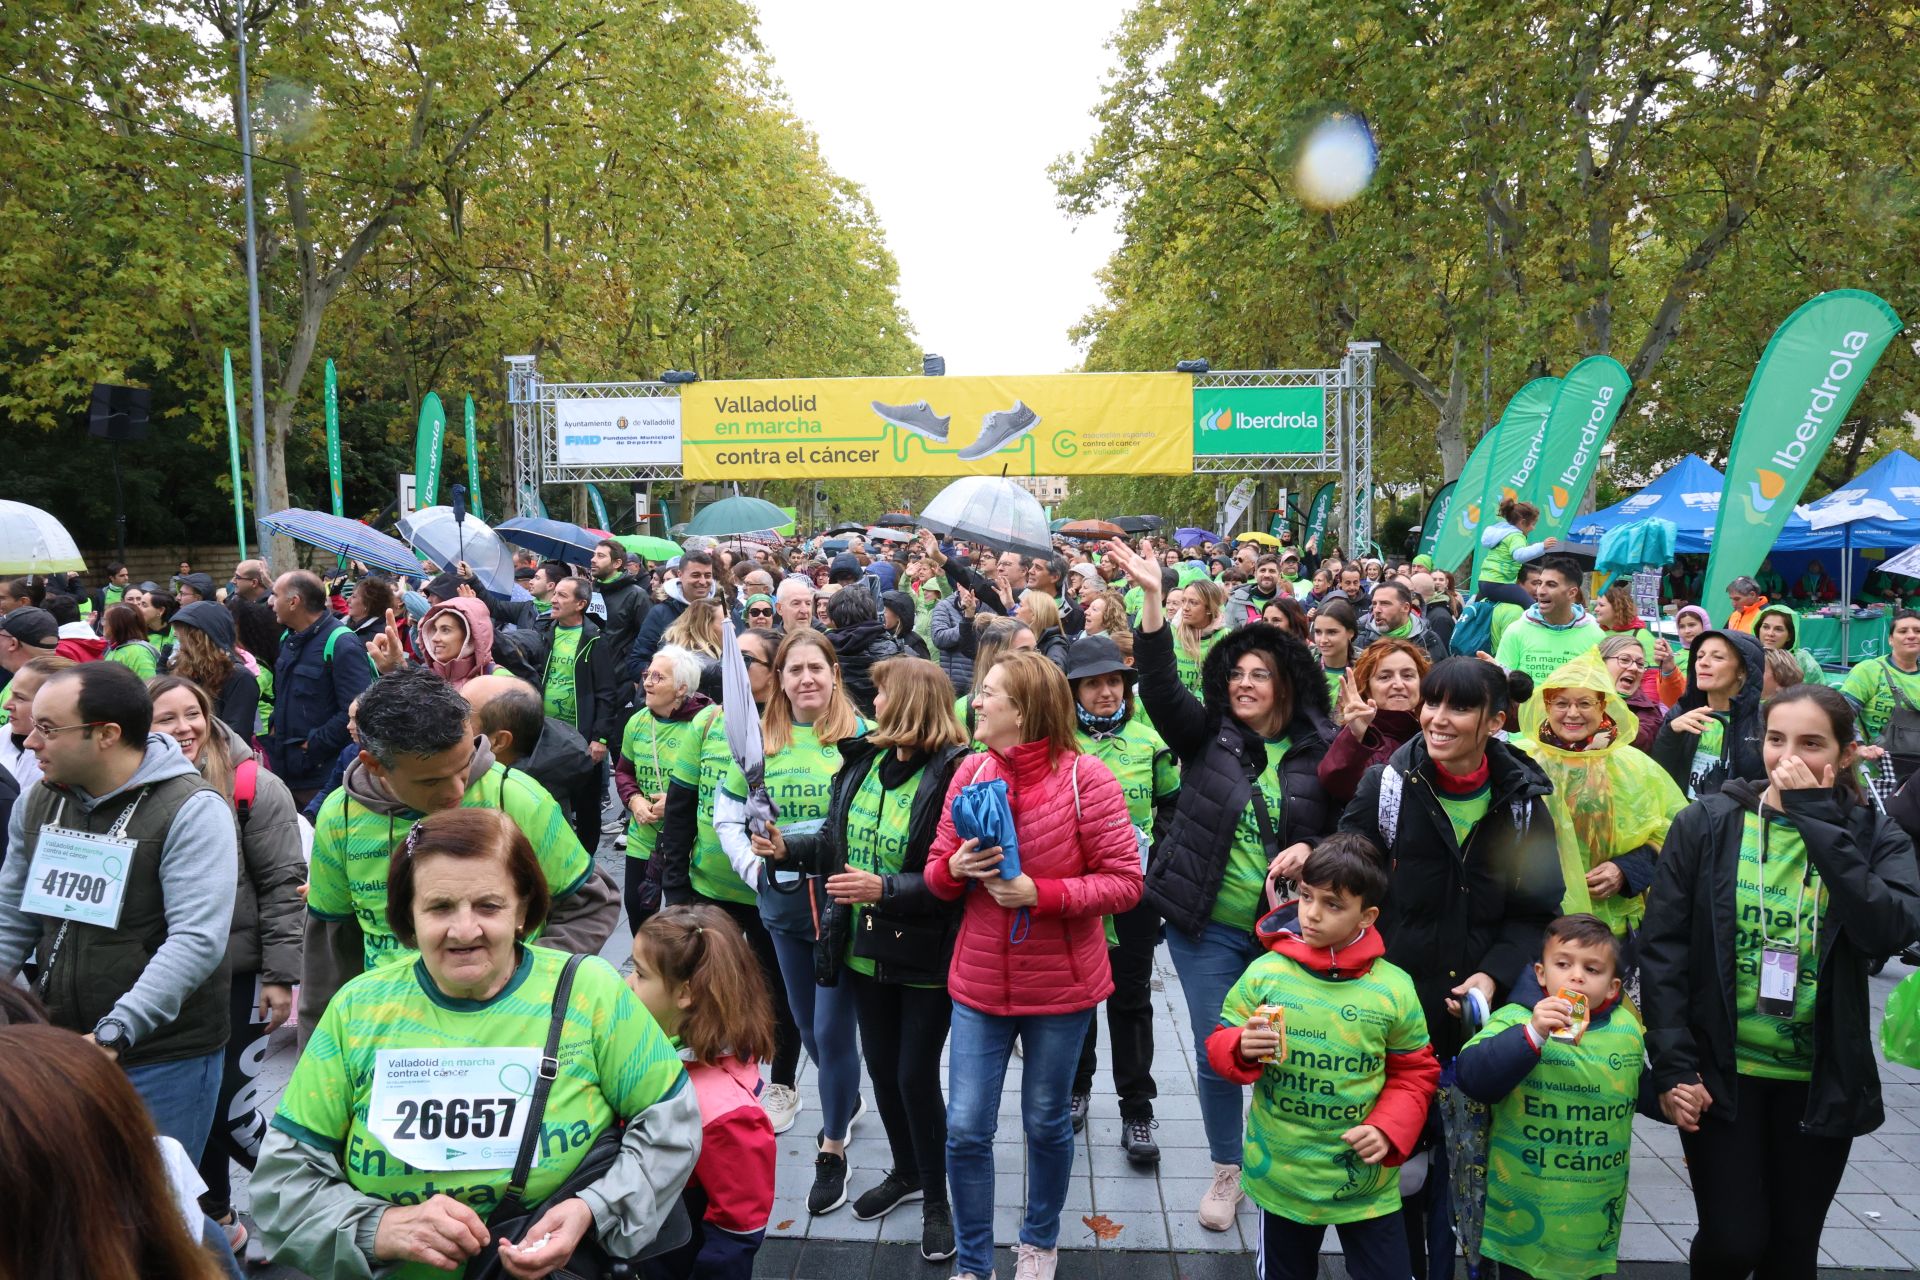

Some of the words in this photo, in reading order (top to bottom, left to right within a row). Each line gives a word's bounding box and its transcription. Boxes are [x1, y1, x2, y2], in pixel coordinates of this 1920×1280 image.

[714, 394, 817, 414] Valladolid
[1771, 330, 1869, 470] Iberdrola
[564, 420, 612, 428] Ayuntamiento
[643, 418, 675, 426] Valladolid
[715, 421, 740, 435] en
[745, 417, 822, 434] marcha
[1236, 411, 1318, 429] Iberdrola
[565, 435, 601, 446] FMD
[1560, 385, 1614, 487] Iberdrola
[716, 448, 781, 465] contra
[781, 446, 805, 464] el
[809, 446, 880, 464] cáncer
[1510, 407, 1552, 488] Iberdr
[551, 655, 574, 665] arch
[1525, 654, 1537, 662] En
[1539, 656, 1571, 664] march
[1525, 663, 1554, 671] contra
[779, 800, 821, 818] ntra
[43, 847, 62, 855] contra
[45, 839, 74, 851] Valladolid
[348, 849, 389, 861] berdrola
[42, 869, 107, 904] 41790
[1285, 1025, 1327, 1040] lladolid
[388, 1058, 439, 1068] Valladolid
[456, 1058, 495, 1067] marcha
[1291, 1050, 1381, 1073] marcha
[387, 1069, 419, 1078] contra
[421, 1068, 431, 1077] el
[433, 1068, 468, 1077] cáncer
[1264, 1066, 1335, 1096] contra
[1544, 1081, 1601, 1093] Valladolid
[1279, 1096, 1367, 1121] cáncer
[1524, 1094, 1558, 1119] En
[1566, 1097, 1637, 1121] march
[393, 1098, 517, 1140] 26657
[1522, 1125, 1608, 1147] contra
[348, 1133, 386, 1177] En
[1521, 1147, 1547, 1169] el
[1553, 1149, 1628, 1172] cáncer
[368, 1181, 498, 1206] ontra
